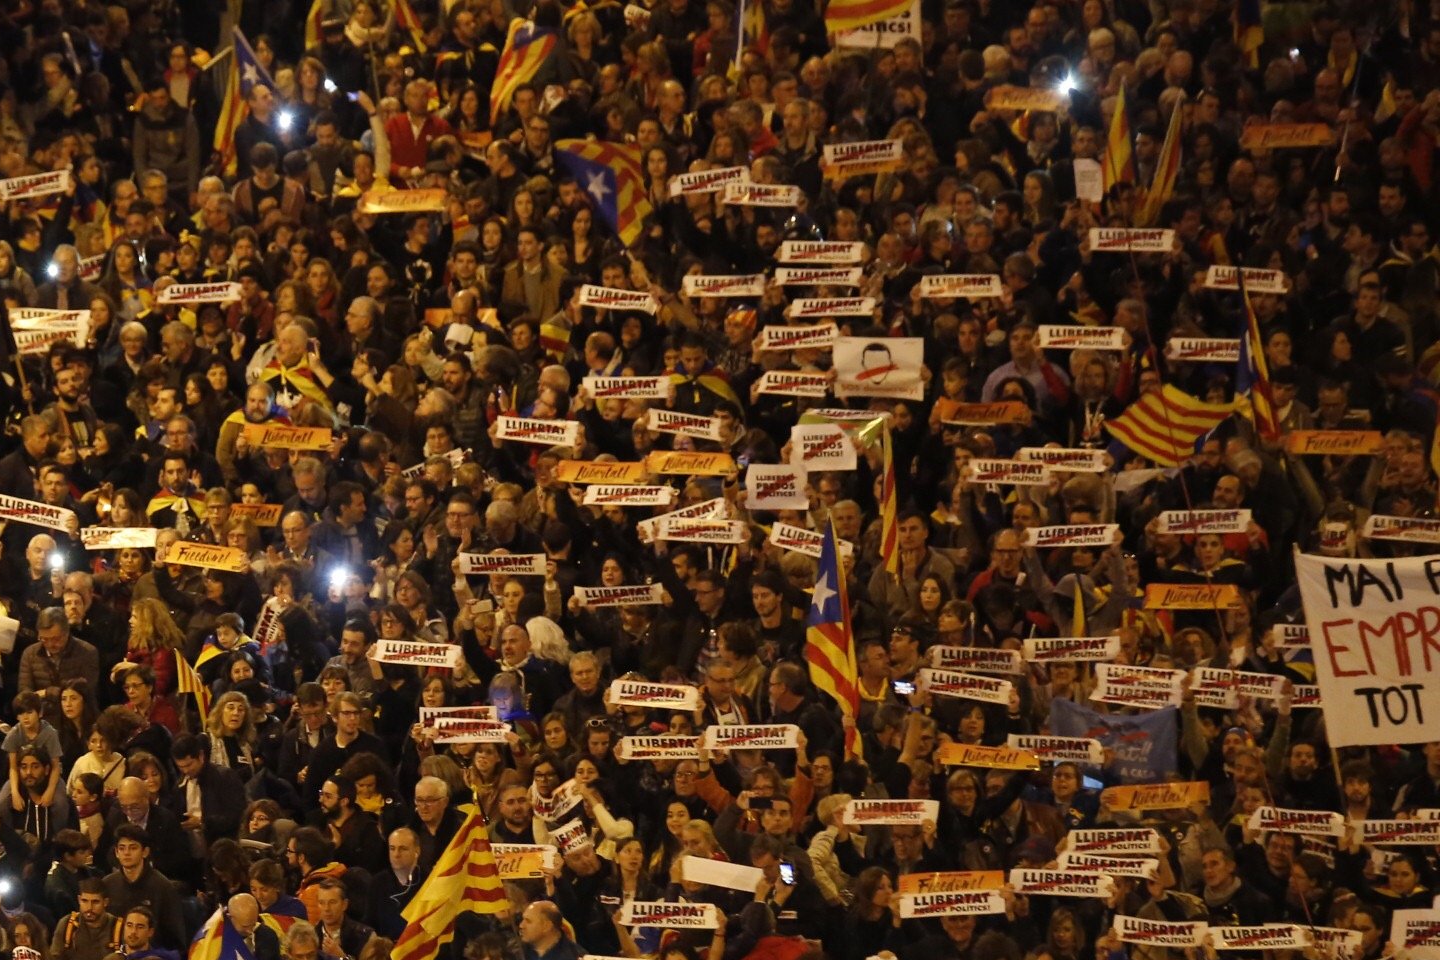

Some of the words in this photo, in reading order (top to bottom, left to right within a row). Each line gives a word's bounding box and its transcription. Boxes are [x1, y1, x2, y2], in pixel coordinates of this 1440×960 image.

[597, 487, 660, 498] LLIBERTAT
[470, 557, 534, 568] LLIBERTAT
[1325, 562, 1403, 608] MAI
[585, 588, 652, 600] LLIBERTAT
[385, 644, 450, 658] LLIBERTAT
[1035, 641, 1106, 654] LLIBERTAT
[941, 651, 1014, 666] LLIBERTAT
[931, 674, 1002, 693] LLIBERTAT
[1202, 671, 1275, 688] LLIBERTAT
[621, 684, 687, 700] LLIBERTAT
[1354, 684, 1424, 727] TOT
[716, 728, 789, 741] LLIBERTAT
[1018, 738, 1090, 753] LLIBERTAT
[1261, 811, 1332, 827] LLIBERTAT
[1076, 832, 1152, 845] LLIBERTAT
[1068, 857, 1143, 871] LLIBERTAT
[1023, 874, 1099, 888] LLIBERTAT
[914, 894, 991, 908] LLIBERTAT
[633, 905, 707, 918] LLIBERTAT
[1124, 921, 1196, 937] LLIBERTAT
[1222, 929, 1294, 942] LLIBERTAT
